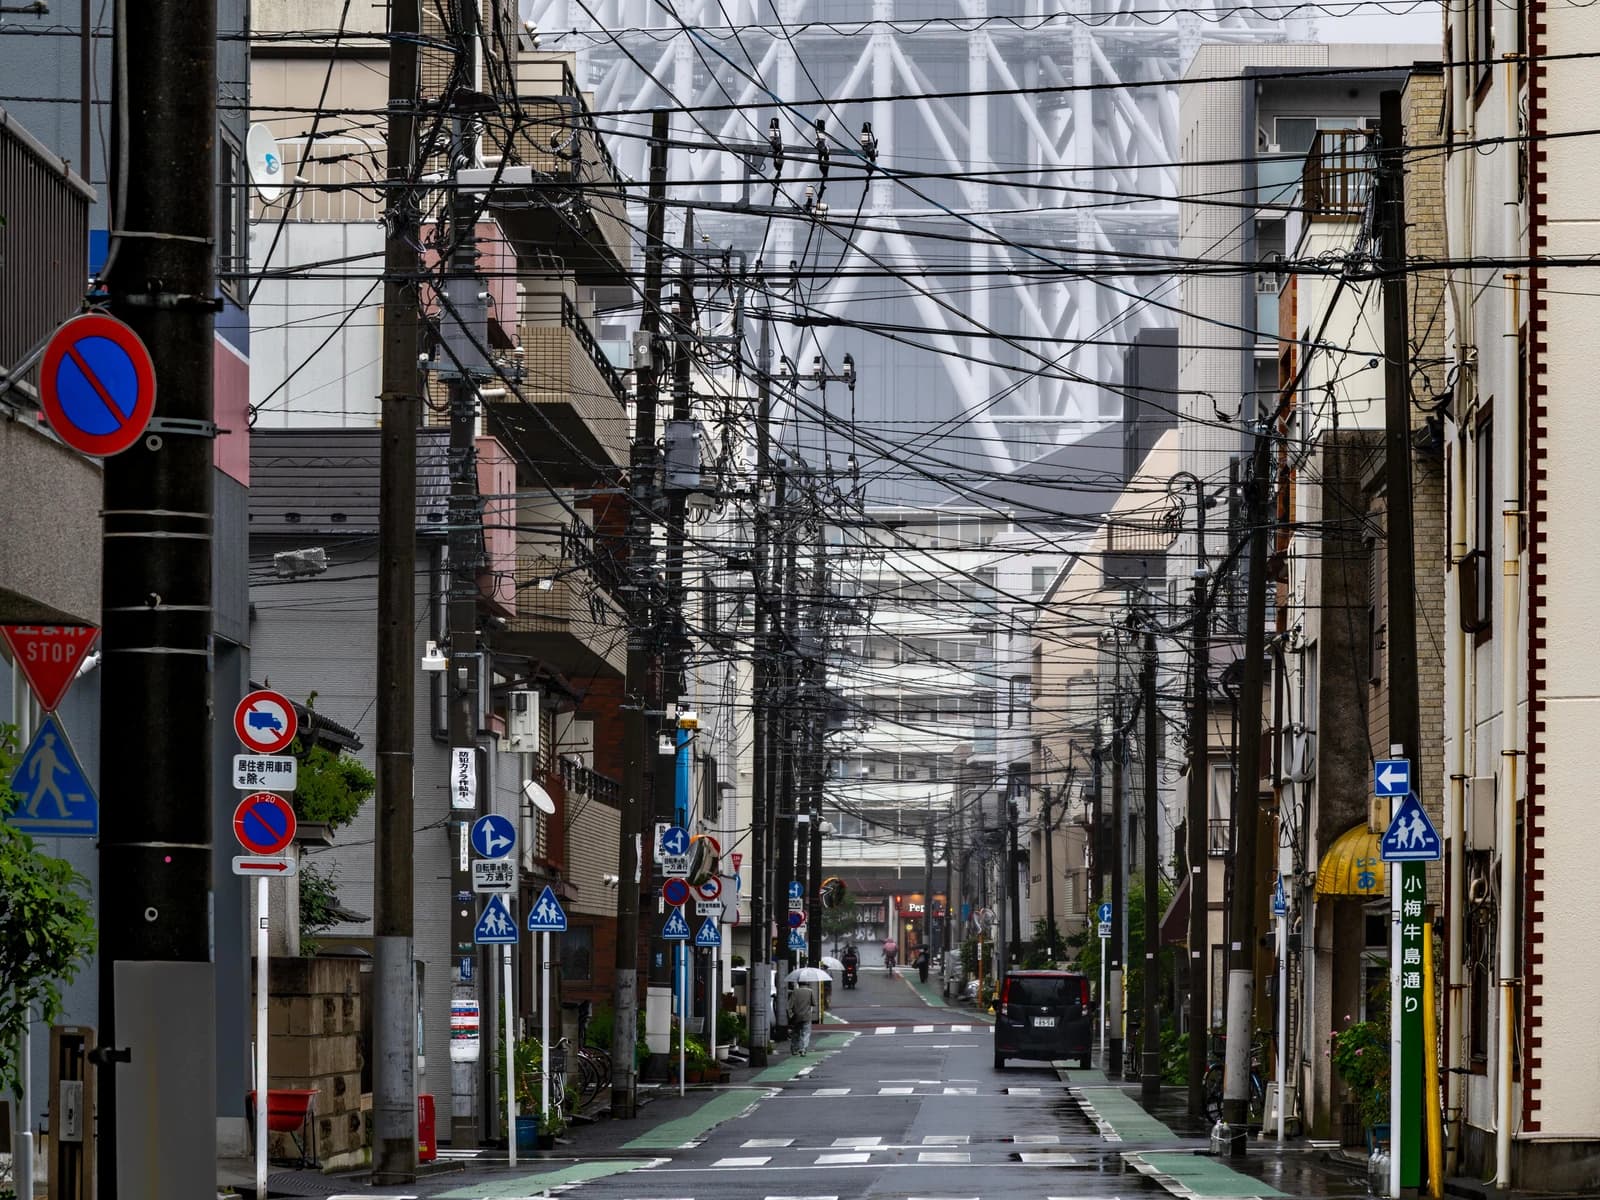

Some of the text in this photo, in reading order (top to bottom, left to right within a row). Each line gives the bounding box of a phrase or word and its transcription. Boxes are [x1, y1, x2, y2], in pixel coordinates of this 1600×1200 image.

[27, 641, 76, 663] STOP
[238, 759, 293, 774] 居住者用車両
[238, 773, 266, 786] を除く
[475, 872, 513, 882] 一方通行
[1402, 874, 1422, 1013] 小梅牛島通り
